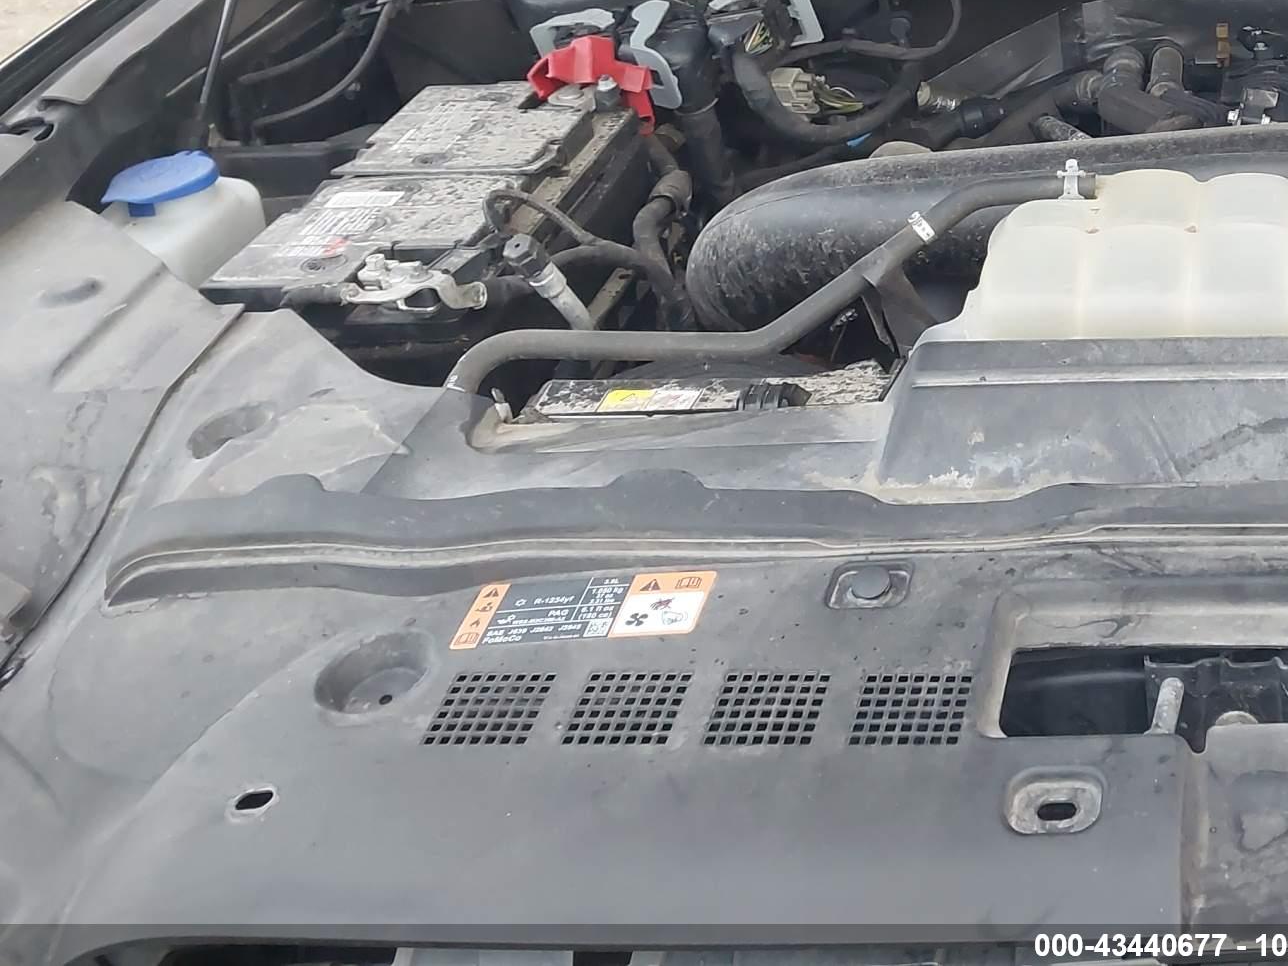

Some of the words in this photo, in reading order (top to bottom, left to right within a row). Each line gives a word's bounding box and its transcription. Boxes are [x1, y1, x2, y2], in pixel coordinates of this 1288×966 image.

[533, 595, 575, 605] R-1234yf
[548, 609, 570, 618] PAG
[487, 629, 505, 637] SAE
[481, 634, 523, 644] FoMoCo
